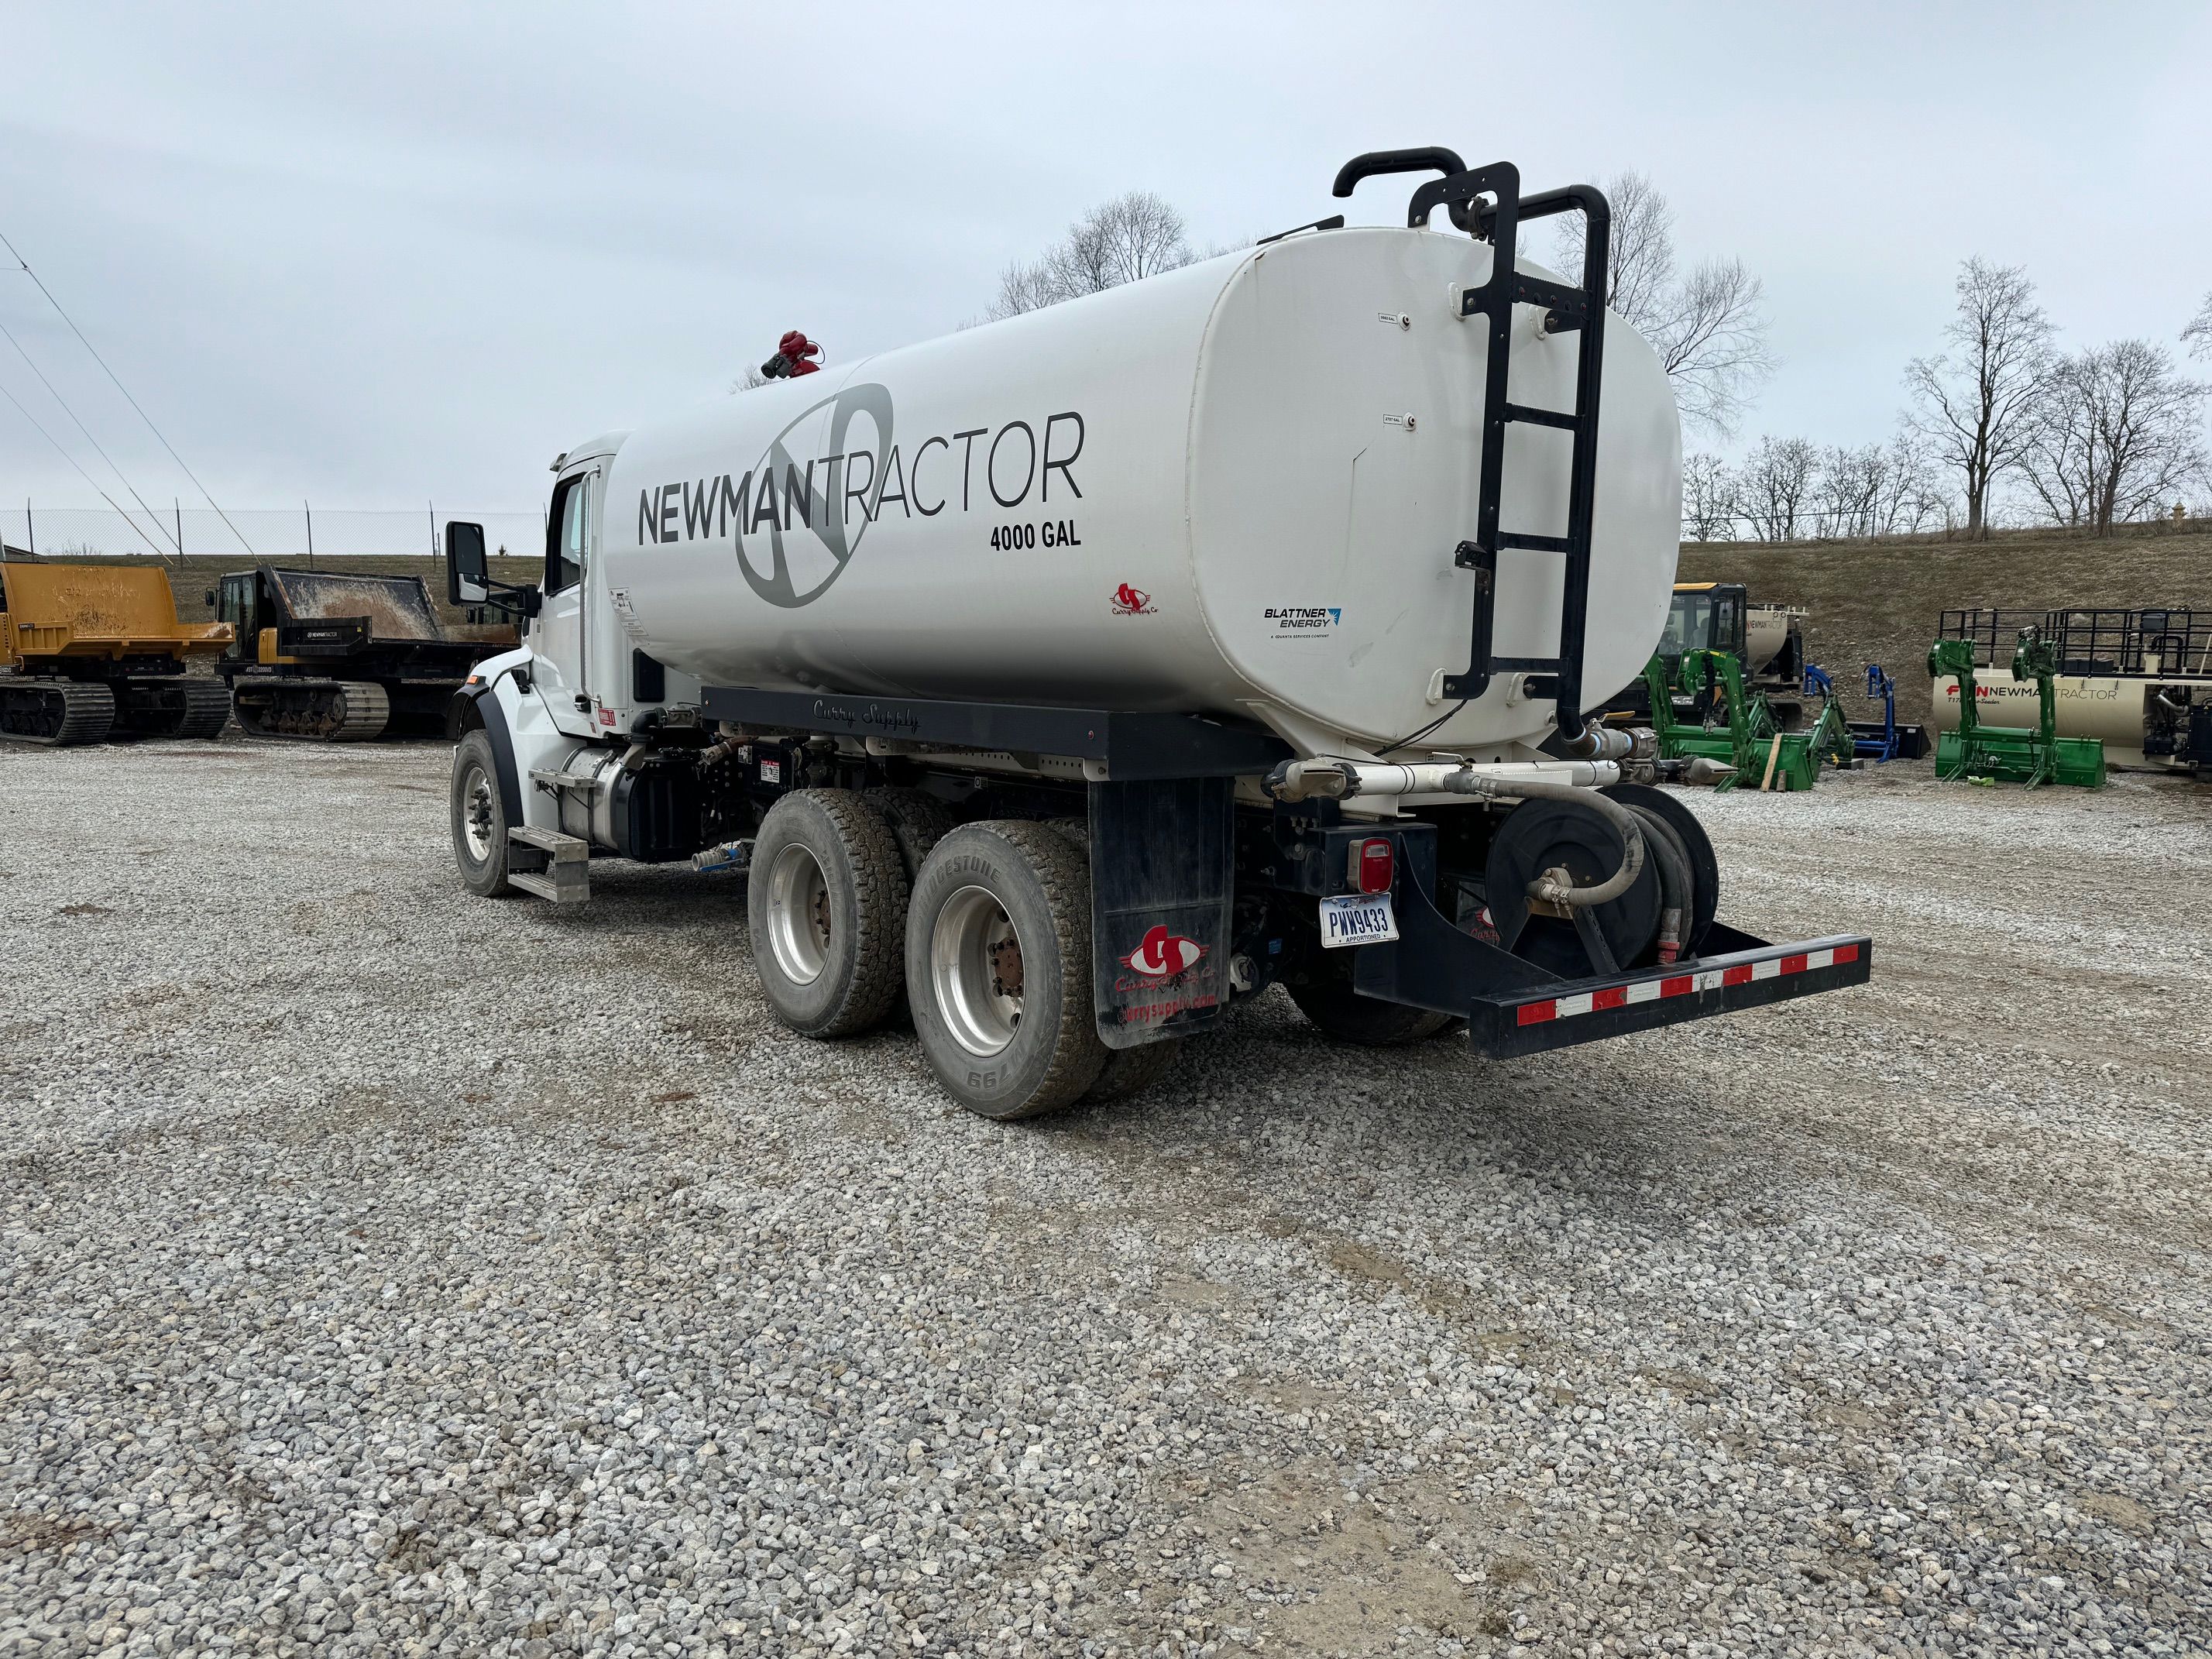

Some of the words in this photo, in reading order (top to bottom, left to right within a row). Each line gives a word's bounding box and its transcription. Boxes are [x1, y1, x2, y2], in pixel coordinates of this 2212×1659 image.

[991, 524, 1035, 551] 4000
[1042, 520, 1081, 548] GAL
[1264, 608, 1326, 618] BLATTNER
[1946, 685, 1989, 697] FN
[814, 699, 856, 729] Curry
[862, 703, 922, 734] Supply
[1329, 908, 1388, 937] PWW9433
[1346, 933, 1381, 943] APPORTIONED
[1115, 976, 1158, 992] Curry
